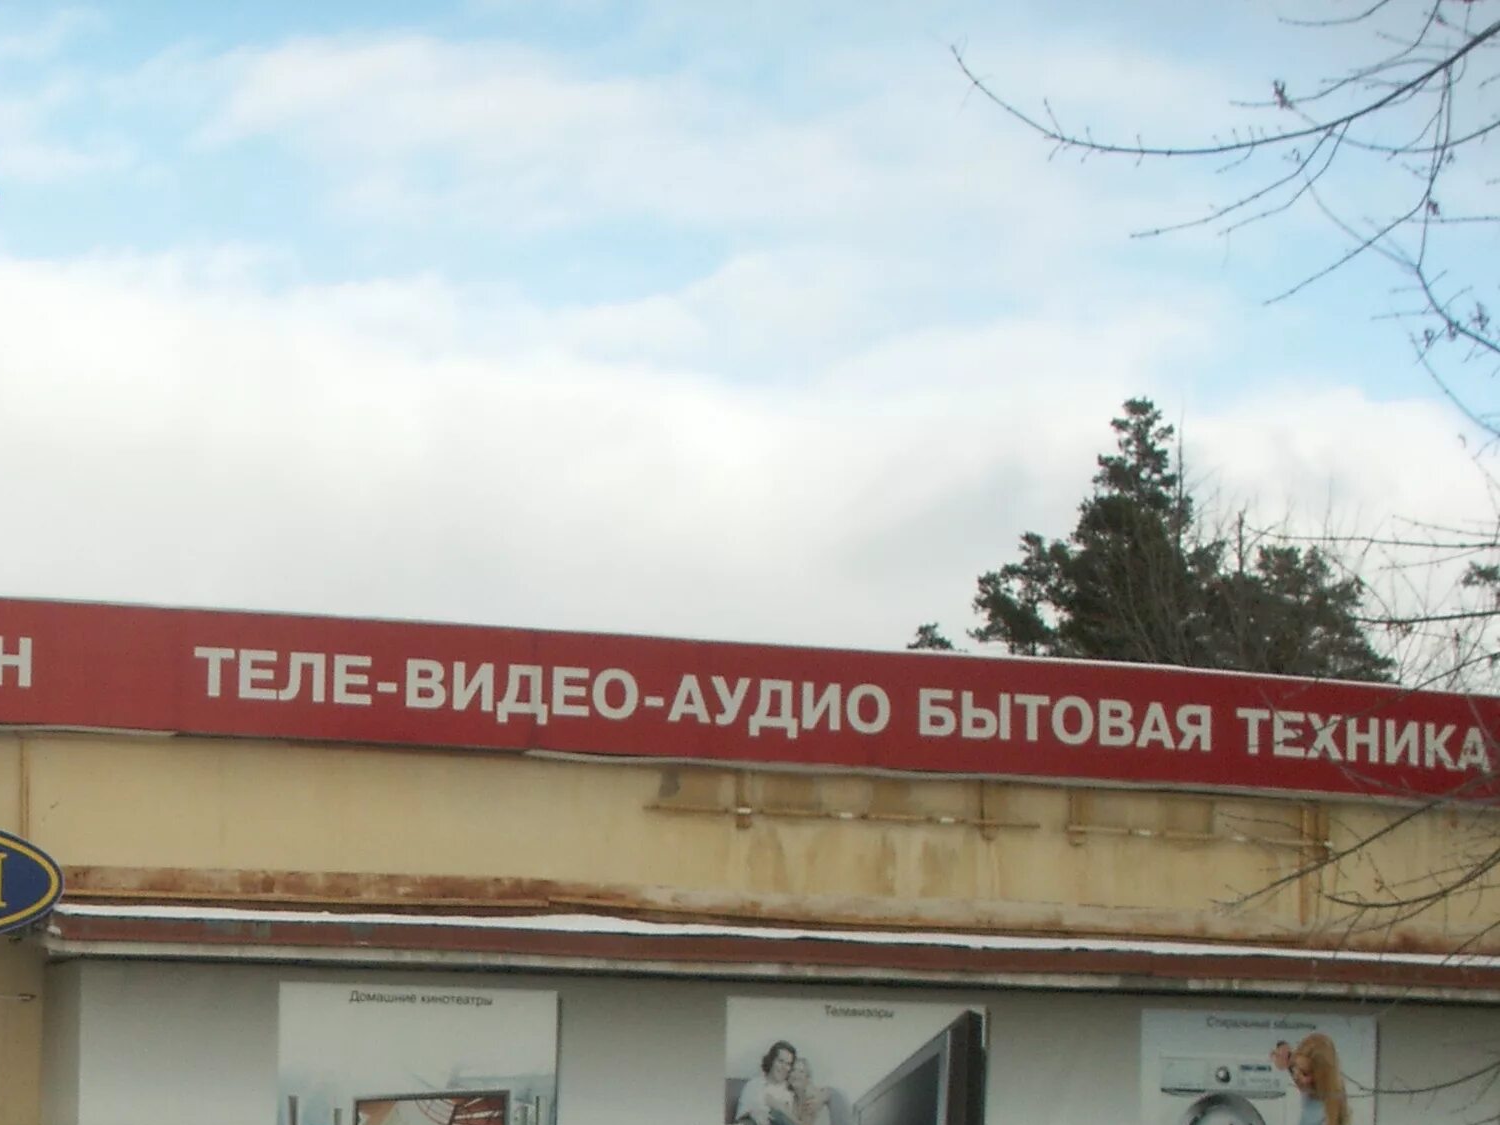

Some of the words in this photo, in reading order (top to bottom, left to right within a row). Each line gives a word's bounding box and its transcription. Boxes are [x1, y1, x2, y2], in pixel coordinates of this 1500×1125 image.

[194, 646, 891, 739] ТЕЛЕ-ВИДЕО-АУДИО
[918, 687, 1212, 752] БЫТОВАЯ
[1237, 708, 1491, 774] ТЕХНИКА
[349, 990, 417, 1004] Домашние
